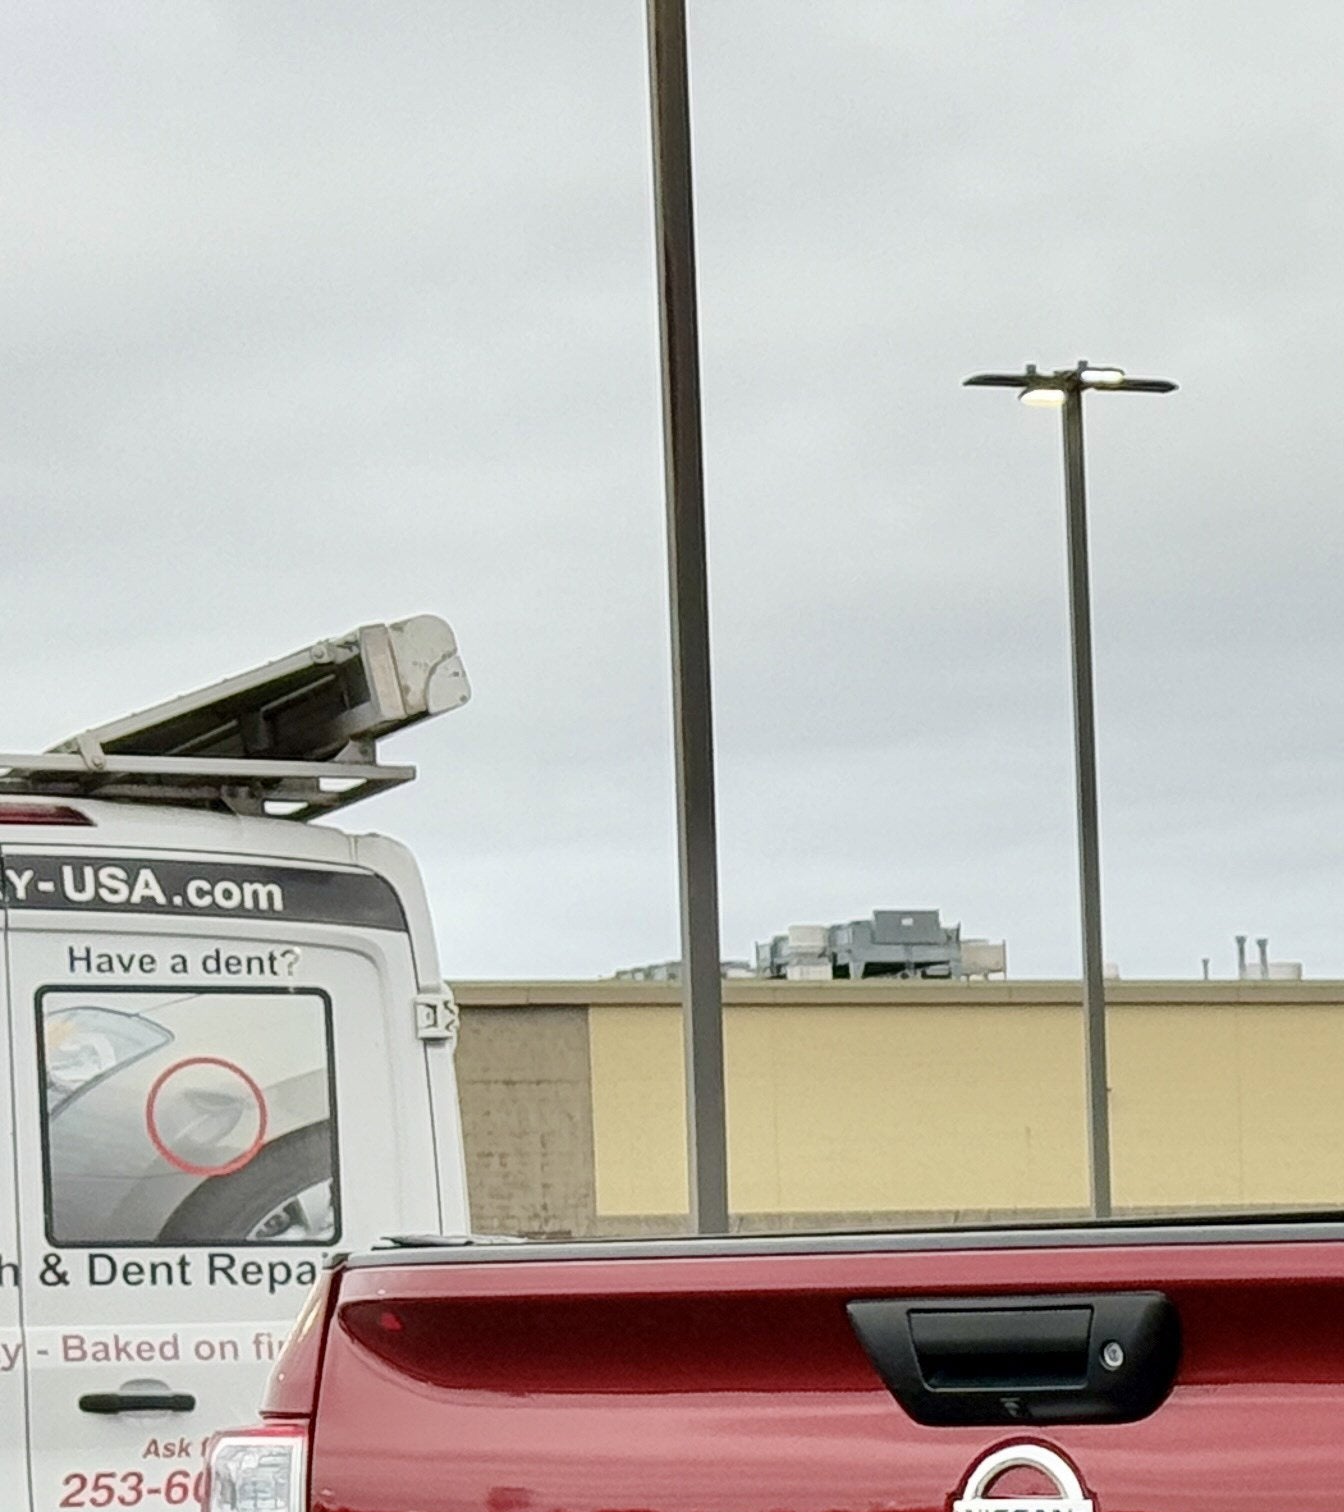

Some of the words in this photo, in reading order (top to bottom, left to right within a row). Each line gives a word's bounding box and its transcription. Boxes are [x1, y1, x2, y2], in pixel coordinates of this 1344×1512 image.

[0, 865, 284, 912] Y-USA.com
[68, 945, 157, 974] Have
[170, 953, 189, 974] a
[201, 948, 301, 977] dent?
[39, 1252, 71, 1287] &
[87, 1252, 193, 1287] Dent
[207, 1252, 329, 1295] Repa
[62, 1332, 180, 1363] Baked
[194, 1338, 239, 1362] on
[142, 1437, 192, 1459] Ask
